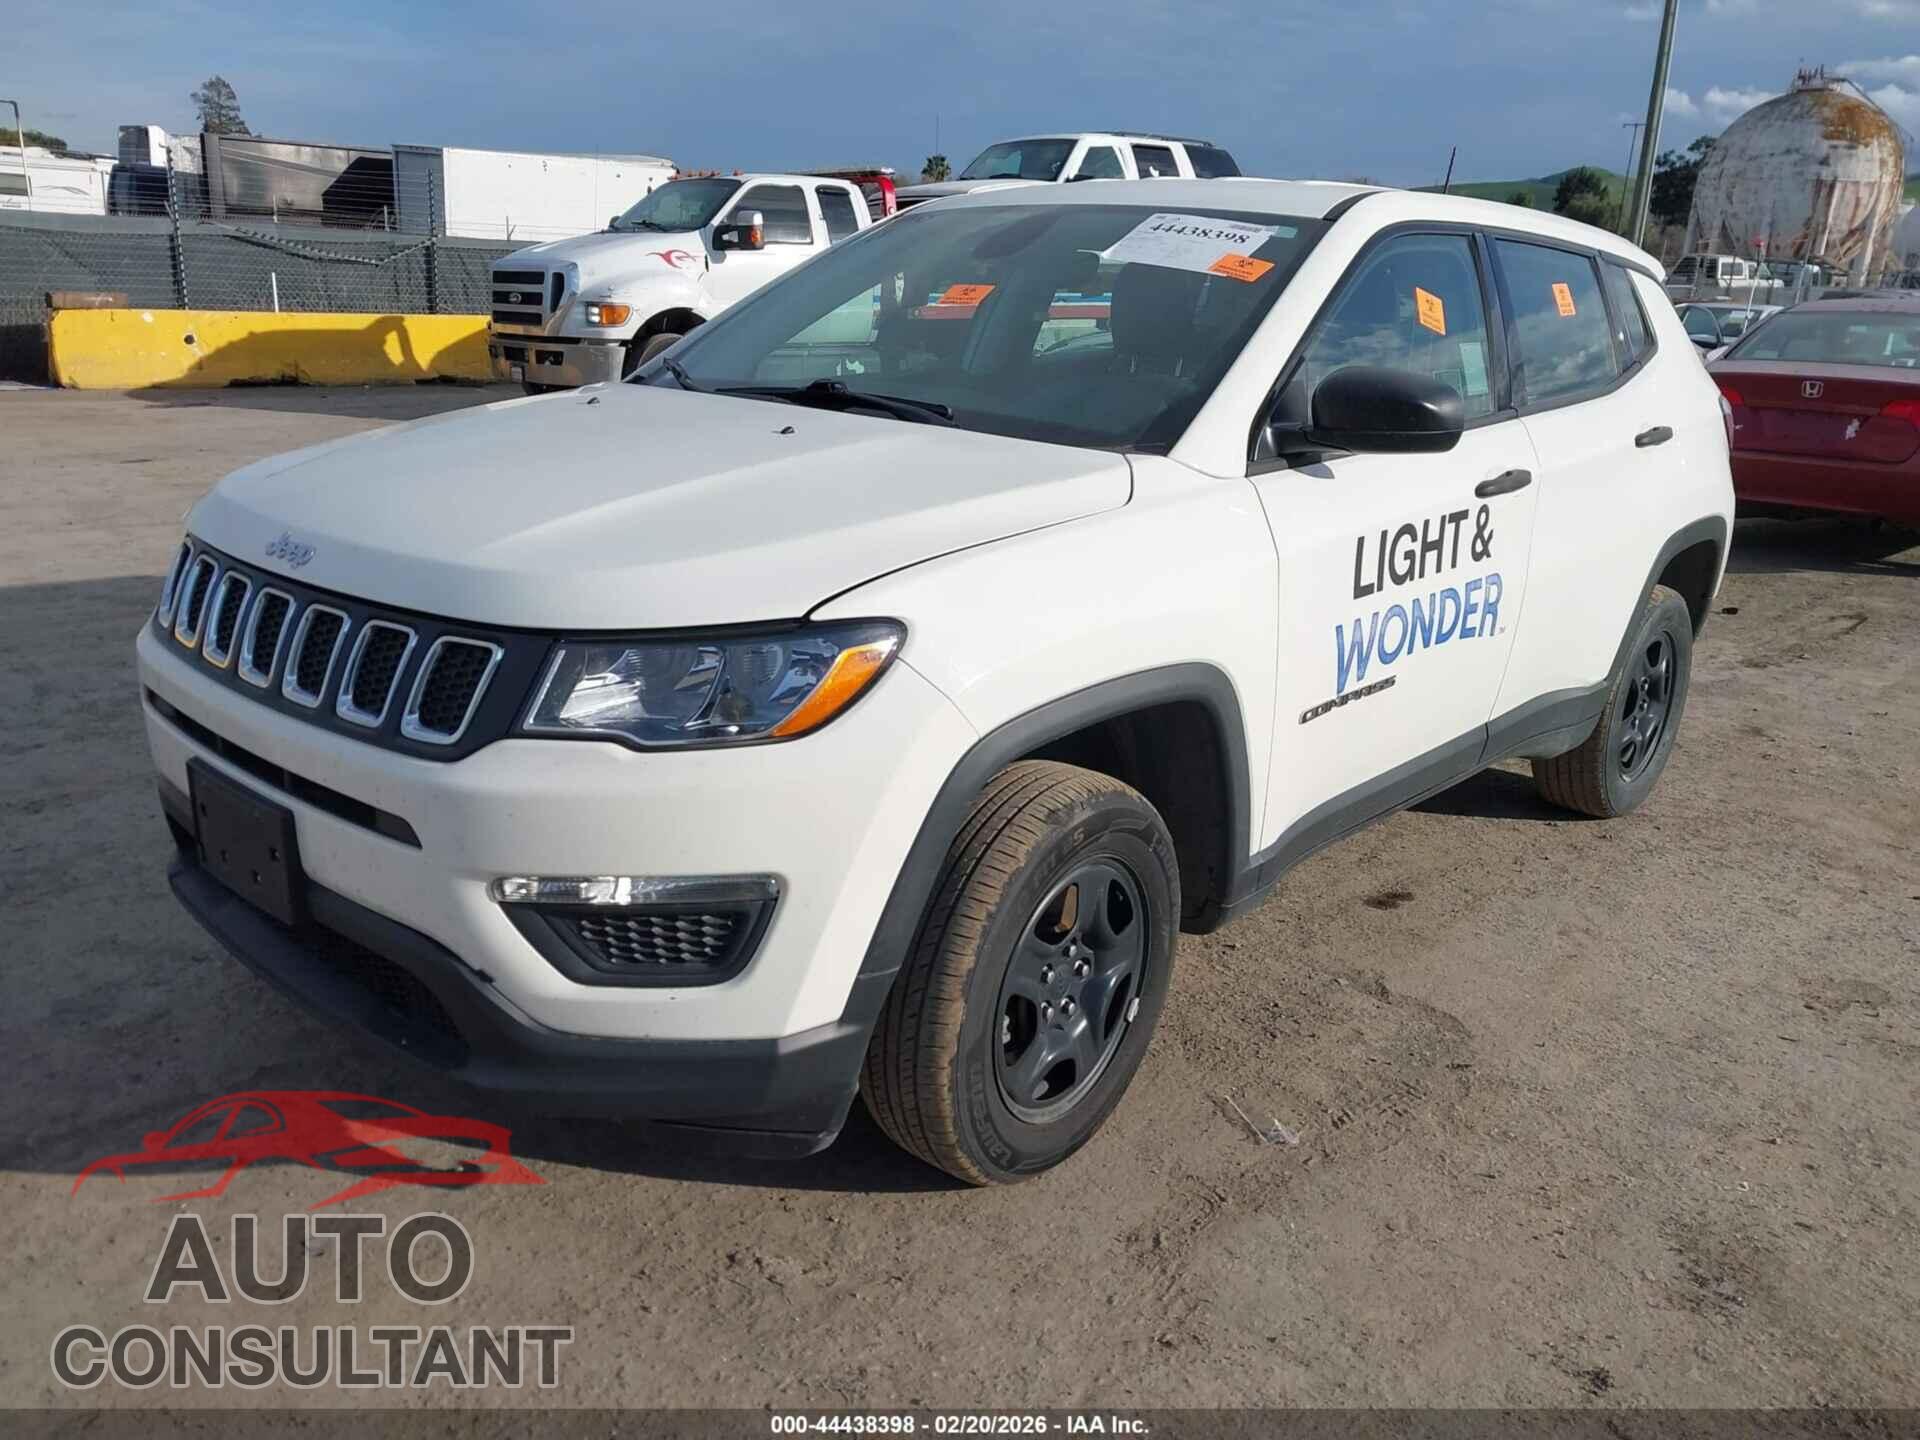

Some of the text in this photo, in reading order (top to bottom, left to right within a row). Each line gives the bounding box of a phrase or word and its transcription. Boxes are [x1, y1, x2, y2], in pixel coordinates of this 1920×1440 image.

[1150, 222, 1251, 244] 44438398
[1353, 503, 1494, 600] LIGHT &
[1335, 572, 1504, 695] WONDER
